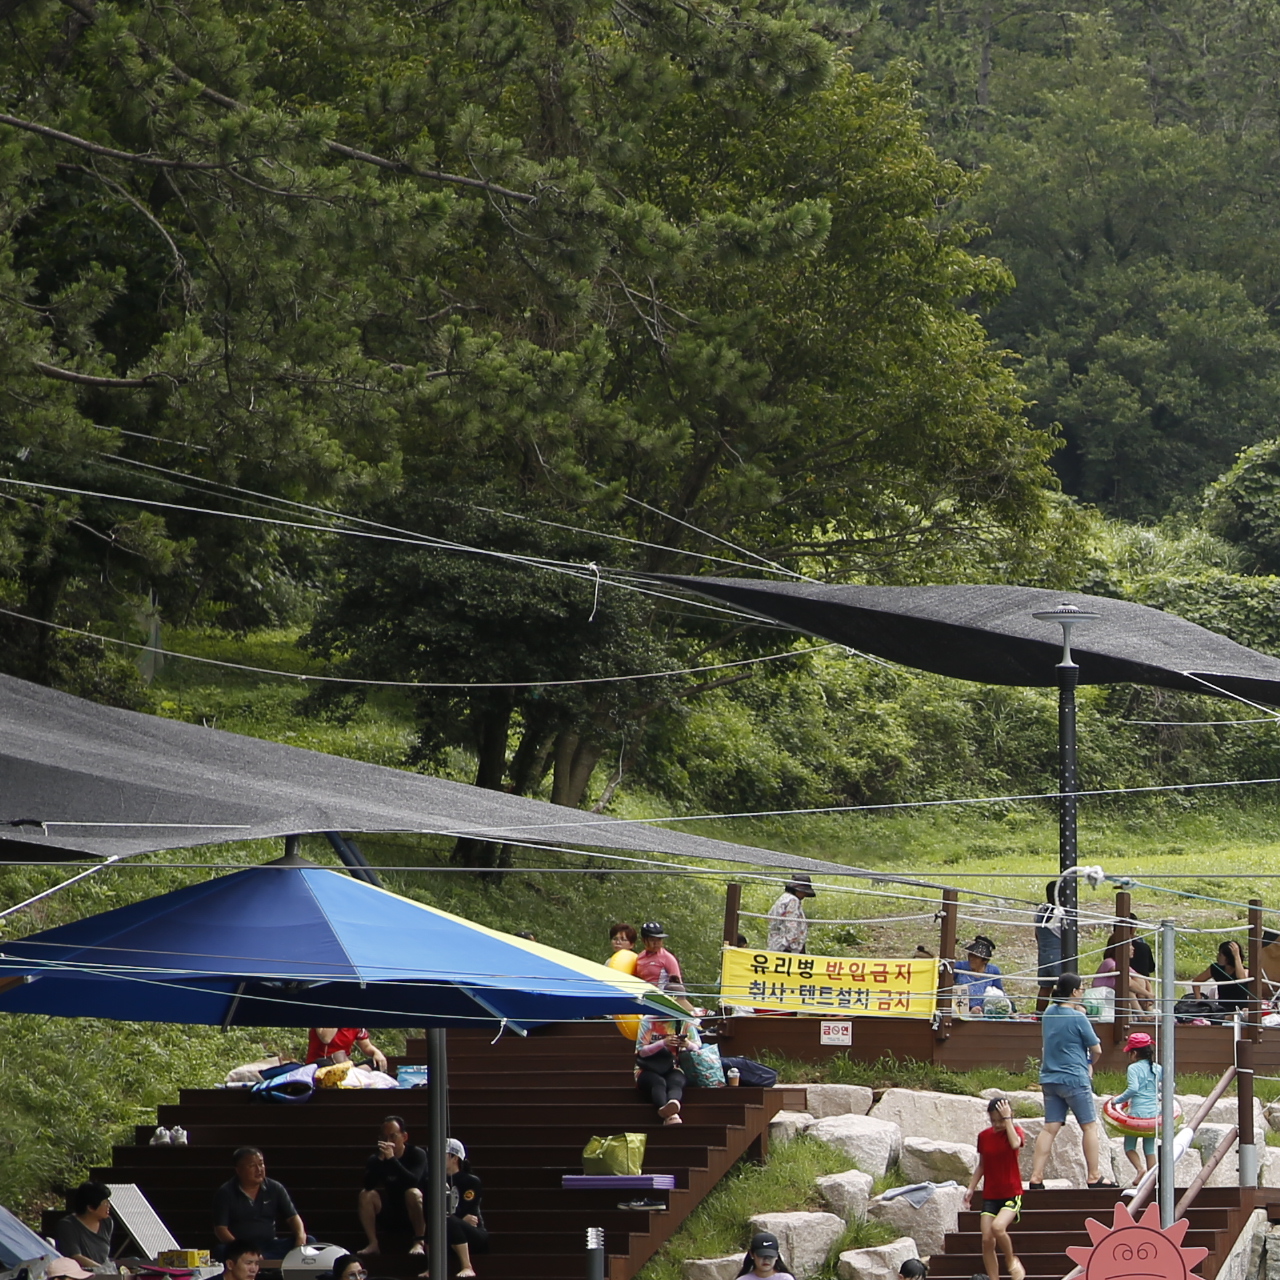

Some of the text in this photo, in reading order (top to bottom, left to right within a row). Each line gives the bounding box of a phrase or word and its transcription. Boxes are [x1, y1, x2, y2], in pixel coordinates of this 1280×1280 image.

[750, 953, 913, 984] 유리병 반입금지
[876, 989, 911, 1012] 금지
